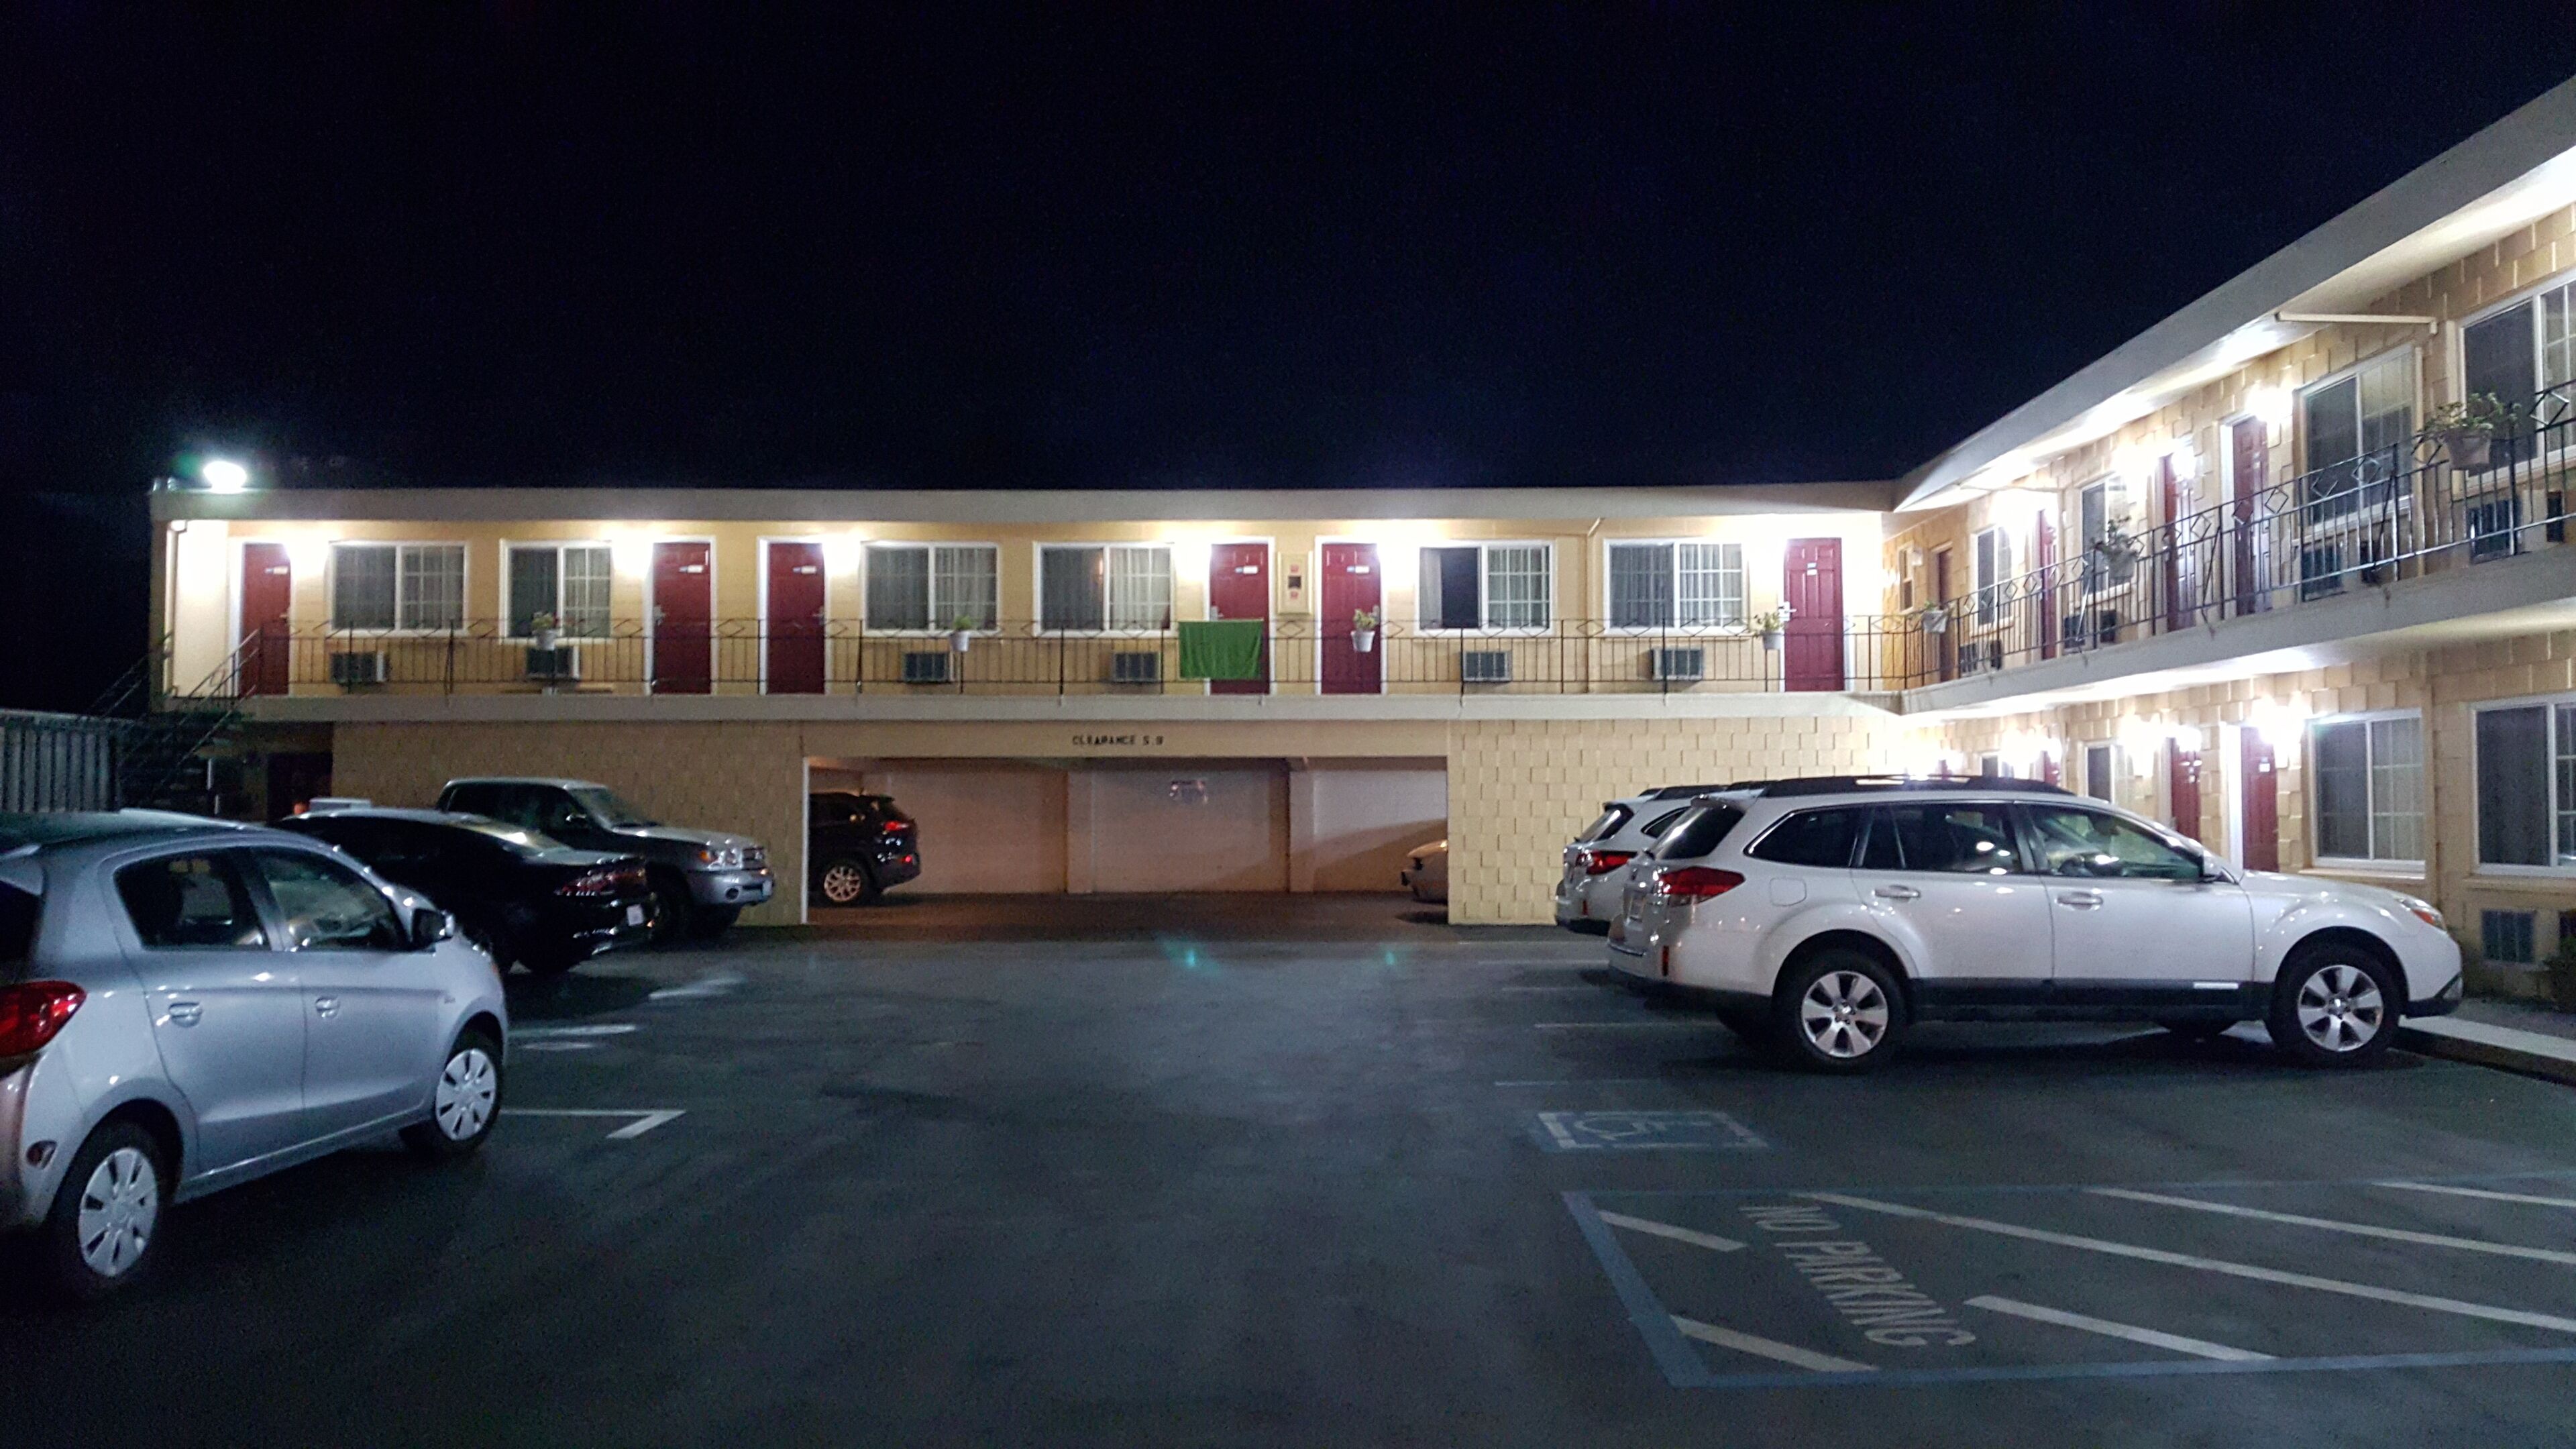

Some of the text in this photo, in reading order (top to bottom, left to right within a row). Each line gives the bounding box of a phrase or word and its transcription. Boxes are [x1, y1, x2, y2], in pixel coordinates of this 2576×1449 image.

[1072, 735, 1136, 745] CLEARANCE
[1738, 1205, 1976, 1346] NO PARKING
